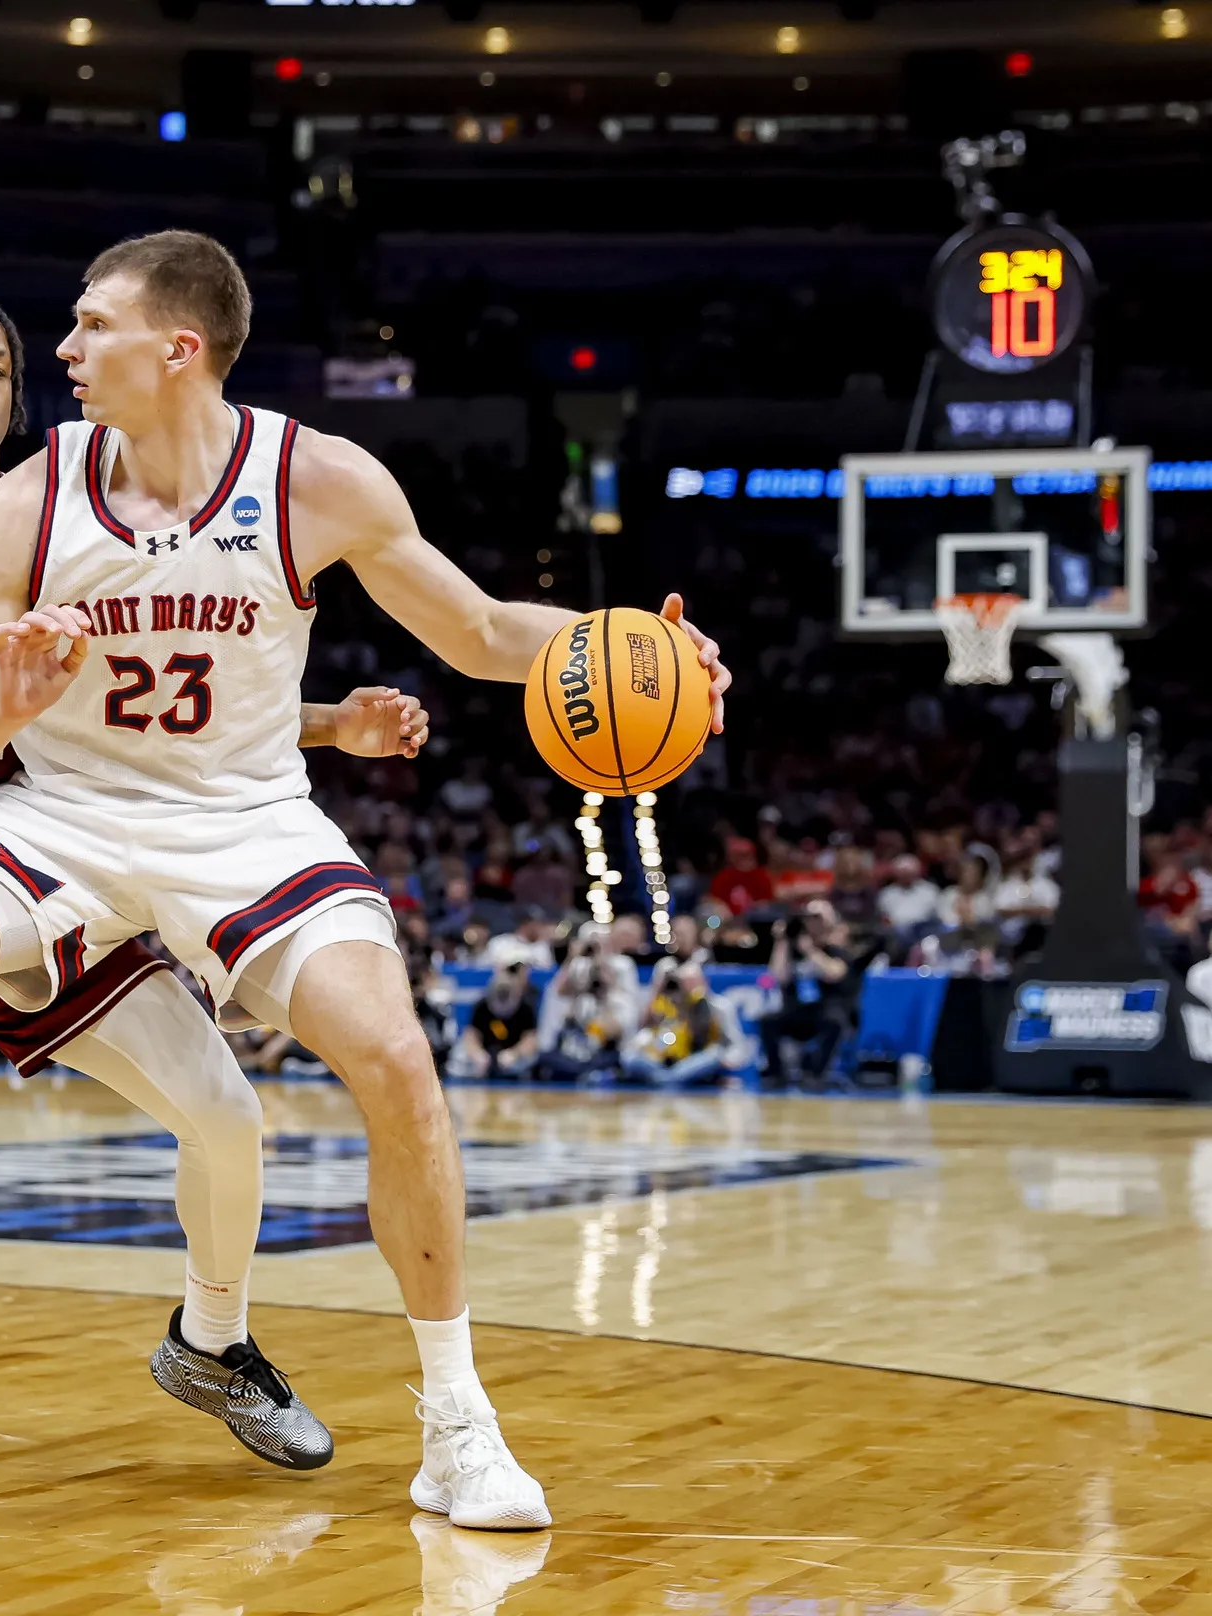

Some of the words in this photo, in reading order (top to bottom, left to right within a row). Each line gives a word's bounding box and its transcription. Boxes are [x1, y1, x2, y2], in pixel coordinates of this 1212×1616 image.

[991, 286, 1057, 358] 10
[235, 509, 260, 519] NCAA
[212, 534, 259, 553] WCC
[58, 597, 141, 637] AINT
[150, 592, 261, 637] MARY'S
[558, 617, 601, 742] Wilson
[631, 647, 645, 683] MARCH
[640, 633, 656, 680] MADNESS
[105, 651, 215, 735] 23
